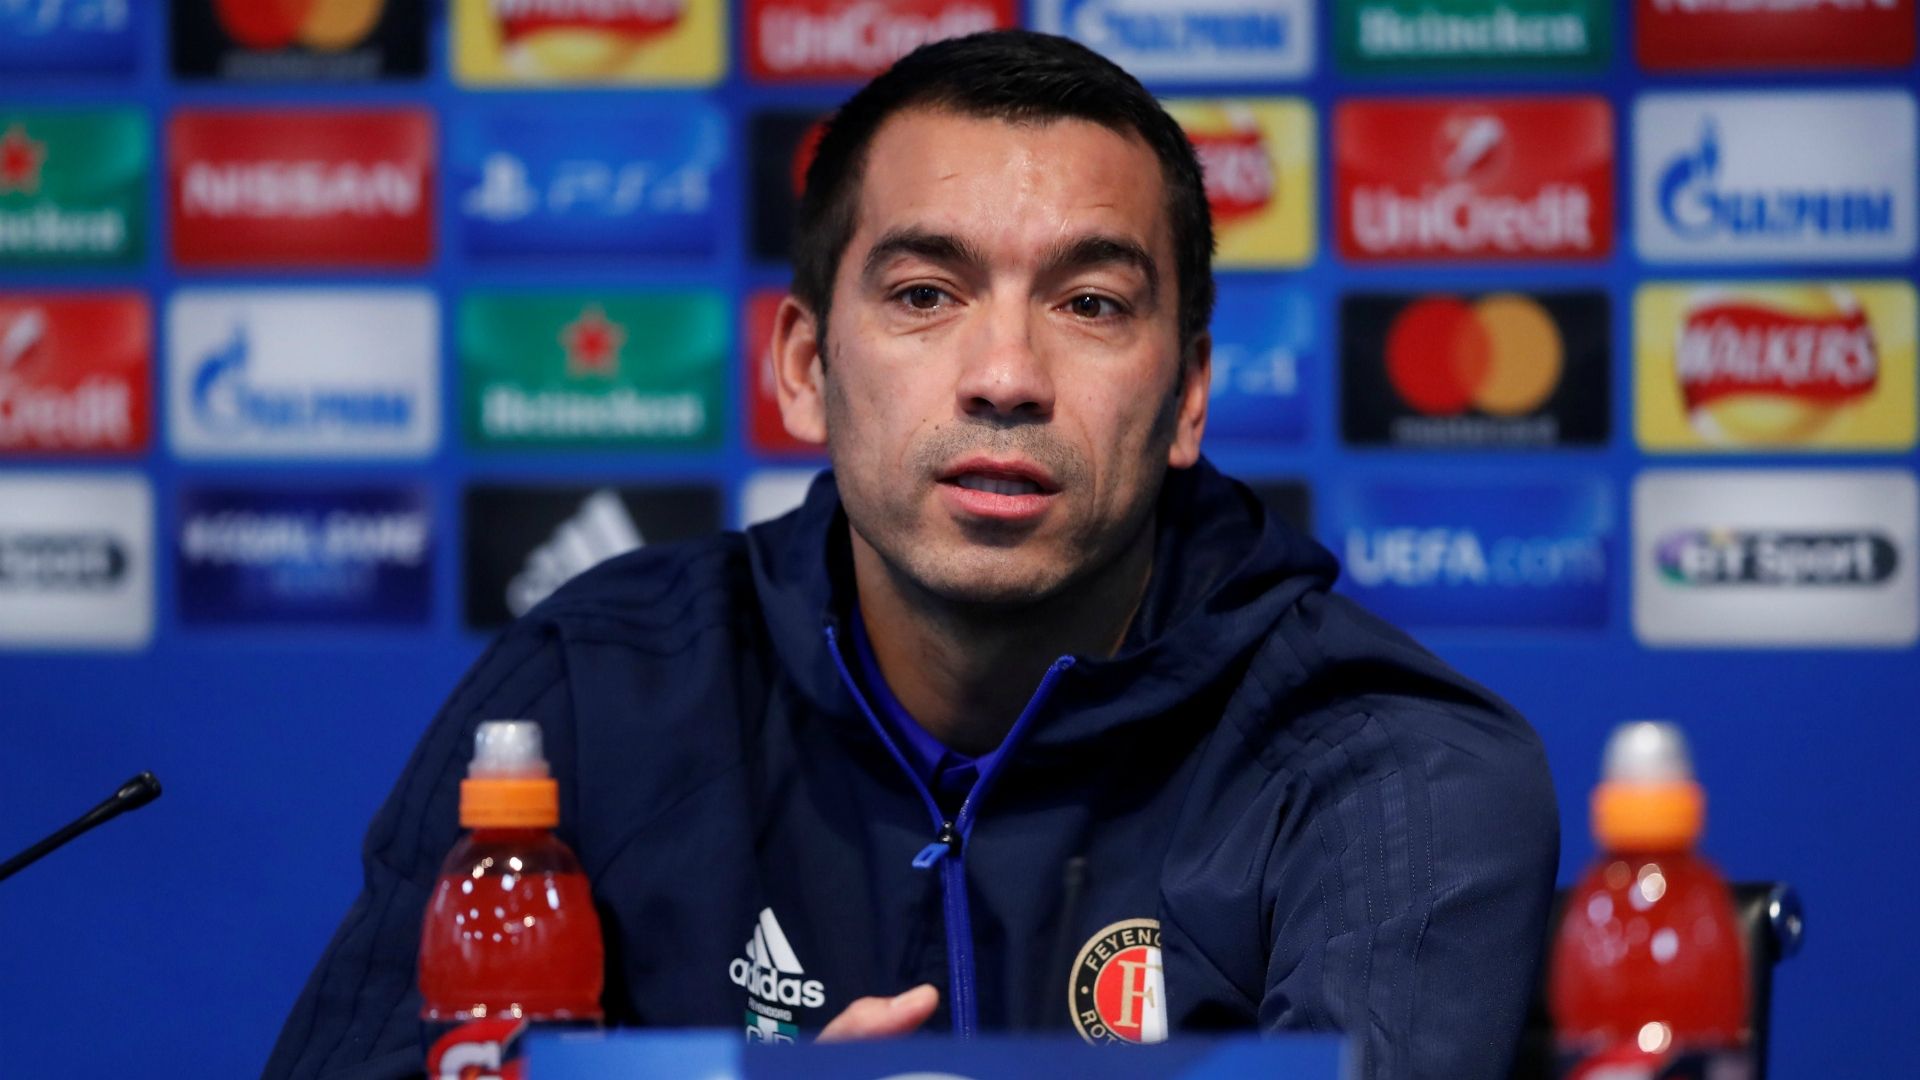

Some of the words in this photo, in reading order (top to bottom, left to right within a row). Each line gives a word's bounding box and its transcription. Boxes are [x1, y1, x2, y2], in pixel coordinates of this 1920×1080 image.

[1357, 4, 1588, 57] Heineken
[181, 160, 420, 217] NISSAN
[1350, 182, 1592, 250] UniCredit
[1676, 318, 1878, 386] WALKERS
[482, 382, 706, 438] Heineken
[1347, 528, 1606, 587] UEFA.com
[729, 957, 825, 1009] adidas
